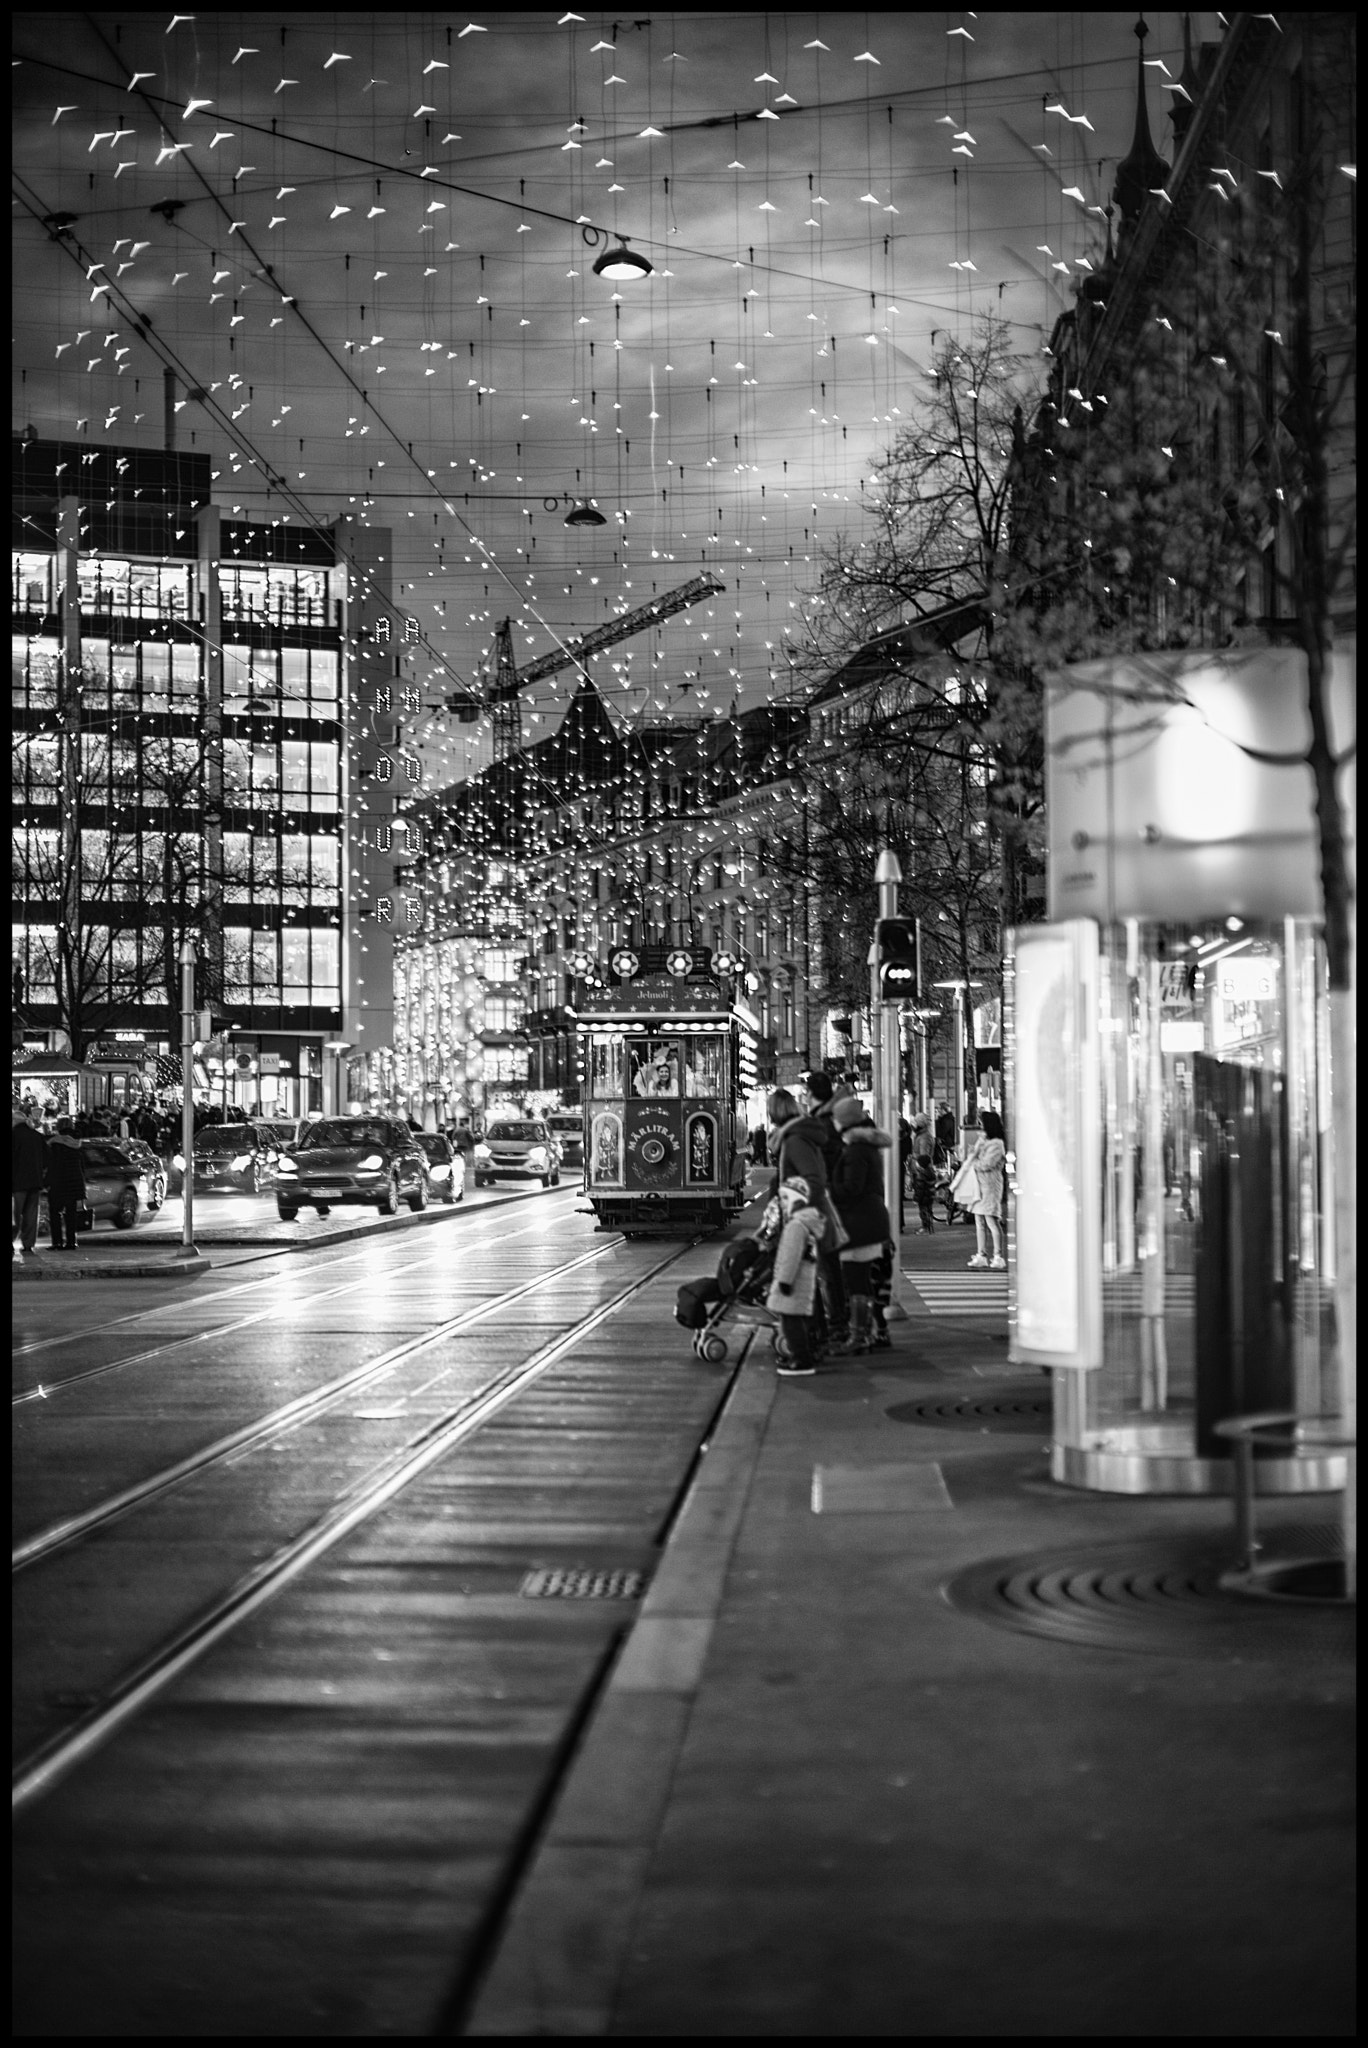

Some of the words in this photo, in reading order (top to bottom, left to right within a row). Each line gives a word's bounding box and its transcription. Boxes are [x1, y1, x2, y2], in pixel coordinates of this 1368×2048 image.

[637, 990, 669, 999] Jelmoli
[262, 1057, 279, 1065] TAXI
[628, 1124, 680, 1151] MÄRLITRAM
